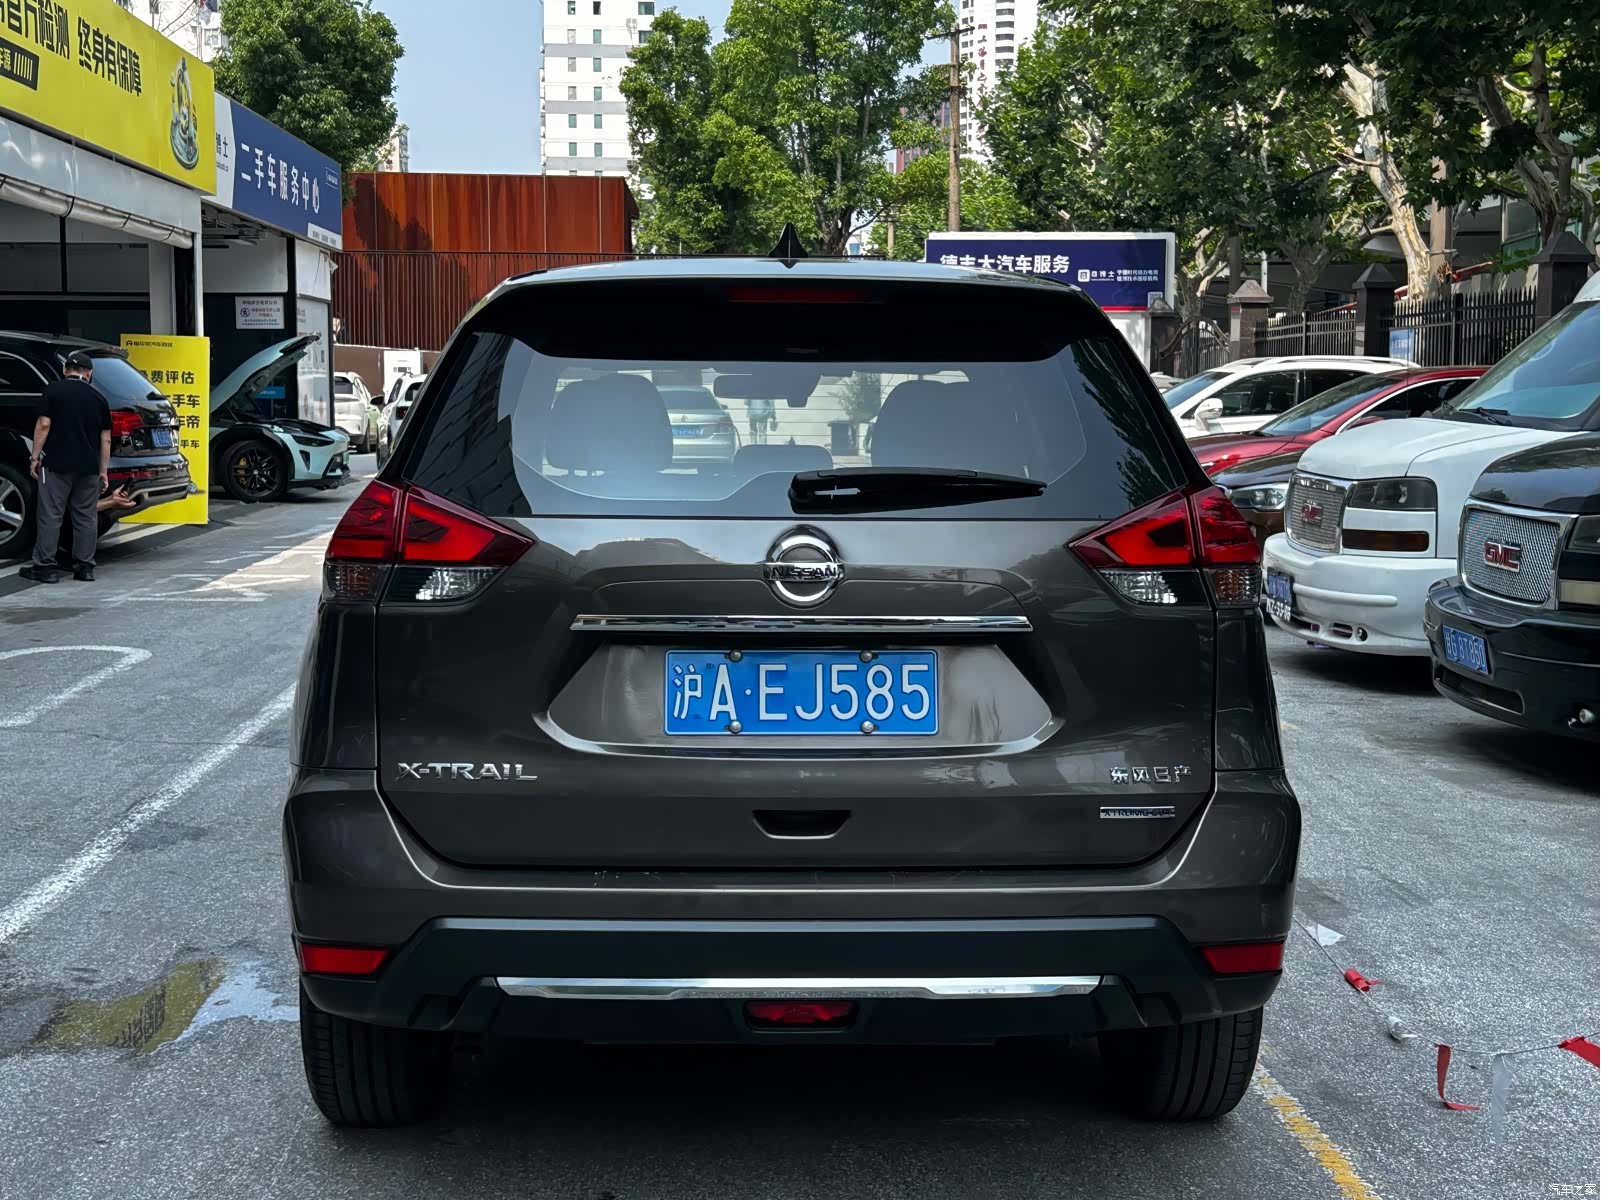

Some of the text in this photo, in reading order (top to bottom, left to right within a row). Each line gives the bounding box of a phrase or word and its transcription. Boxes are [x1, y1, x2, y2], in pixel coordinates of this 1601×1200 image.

[77, 16, 142, 97] 终身有保障
[241, 143, 320, 214] 二手车服务中心
[772, 564, 837, 578] NISSAN
[1484, 541, 1521, 573] GMC
[672, 663, 931, 722] 沪A·EJ585
[395, 762, 538, 781] X-TRAIL
[1110, 764, 1192, 784] 东风日产
